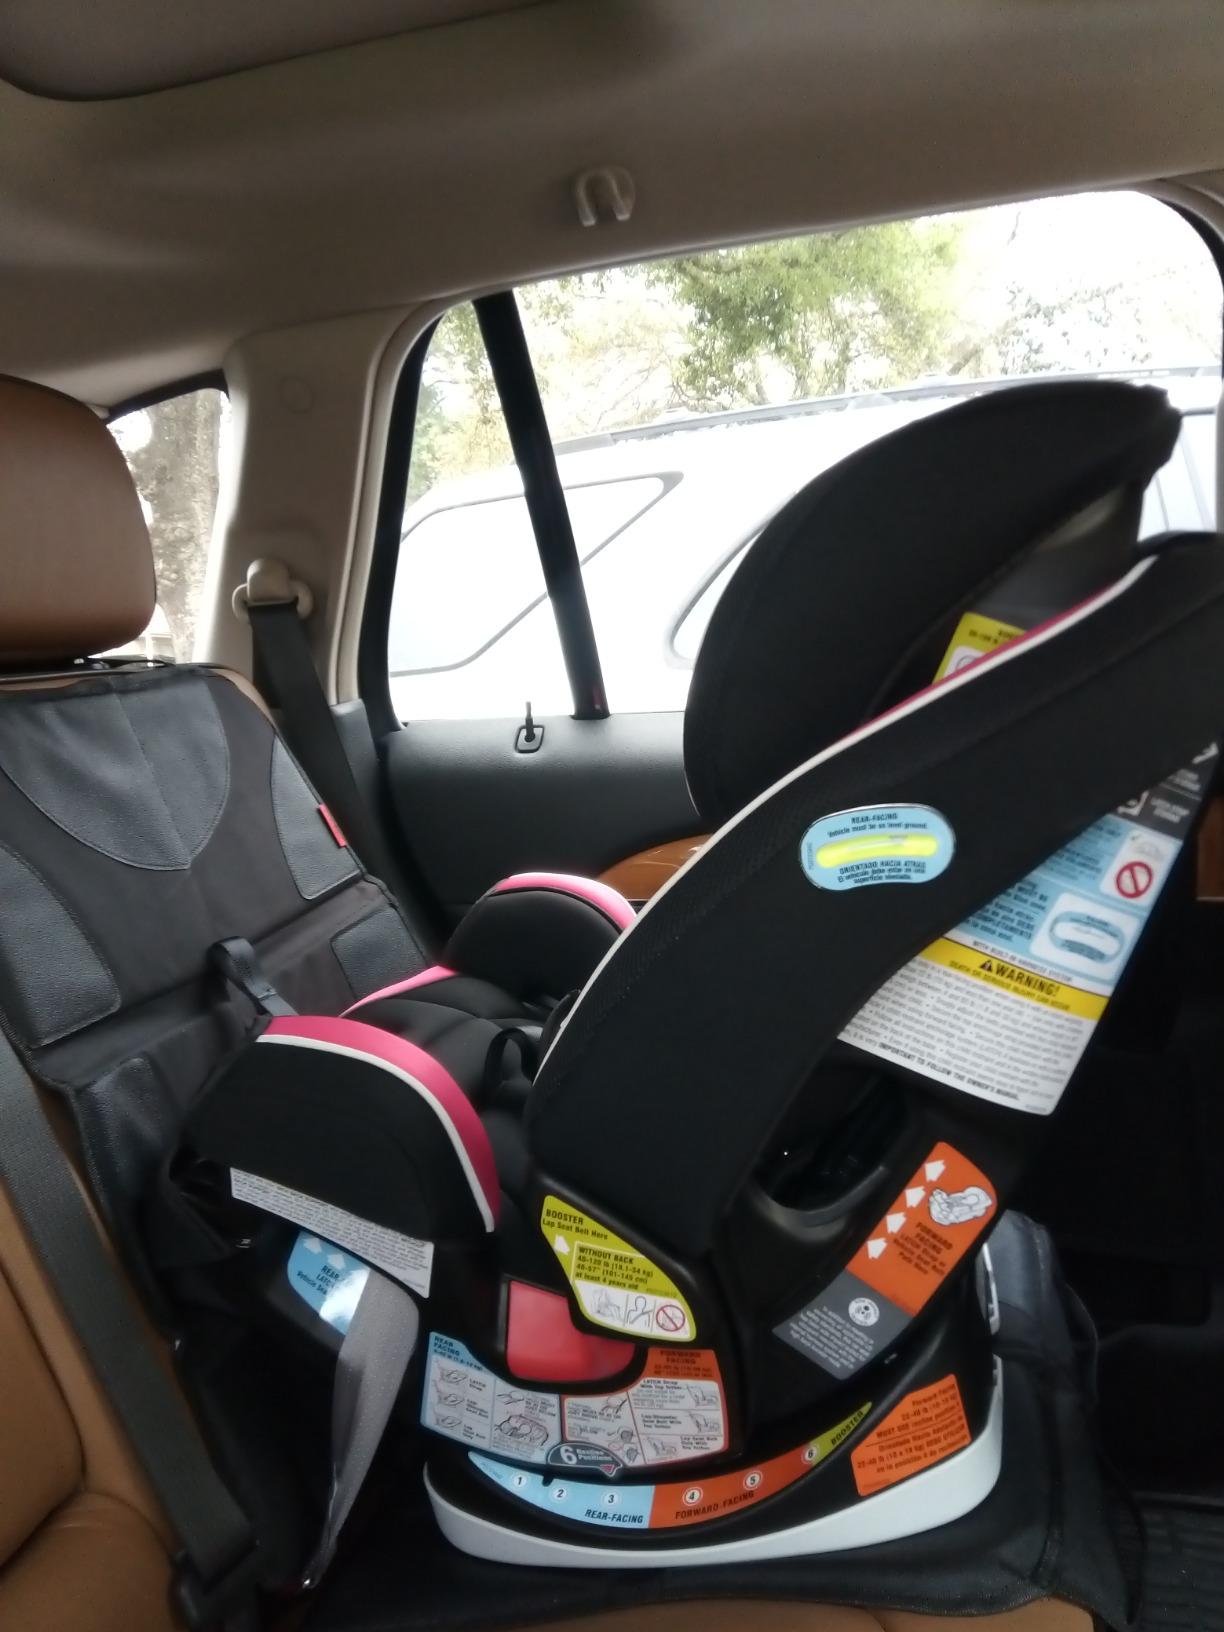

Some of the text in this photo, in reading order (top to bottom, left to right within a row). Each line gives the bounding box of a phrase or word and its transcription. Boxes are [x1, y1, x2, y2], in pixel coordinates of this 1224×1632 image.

[995, 963, 1060, 997] WARNING!
[546, 1208, 584, 1225] BOOSTER
[542, 1218, 608, 1240] Lap Seat Belt Here
[578, 1247, 634, 1264] WITHOUT BACK
[831, 1410, 864, 1446] BOOSTER
[560, 1445, 577, 1465] 6
[807, 1449, 814, 1458] 6
[517, 1476, 522, 1486] 1
[750, 1476, 756, 1485] 5
[557, 1489, 564, 1498] 2
[608, 1495, 614, 1504] 3
[688, 1492, 695, 1500] 4
[584, 1509, 644, 1524] REAR-FACING
